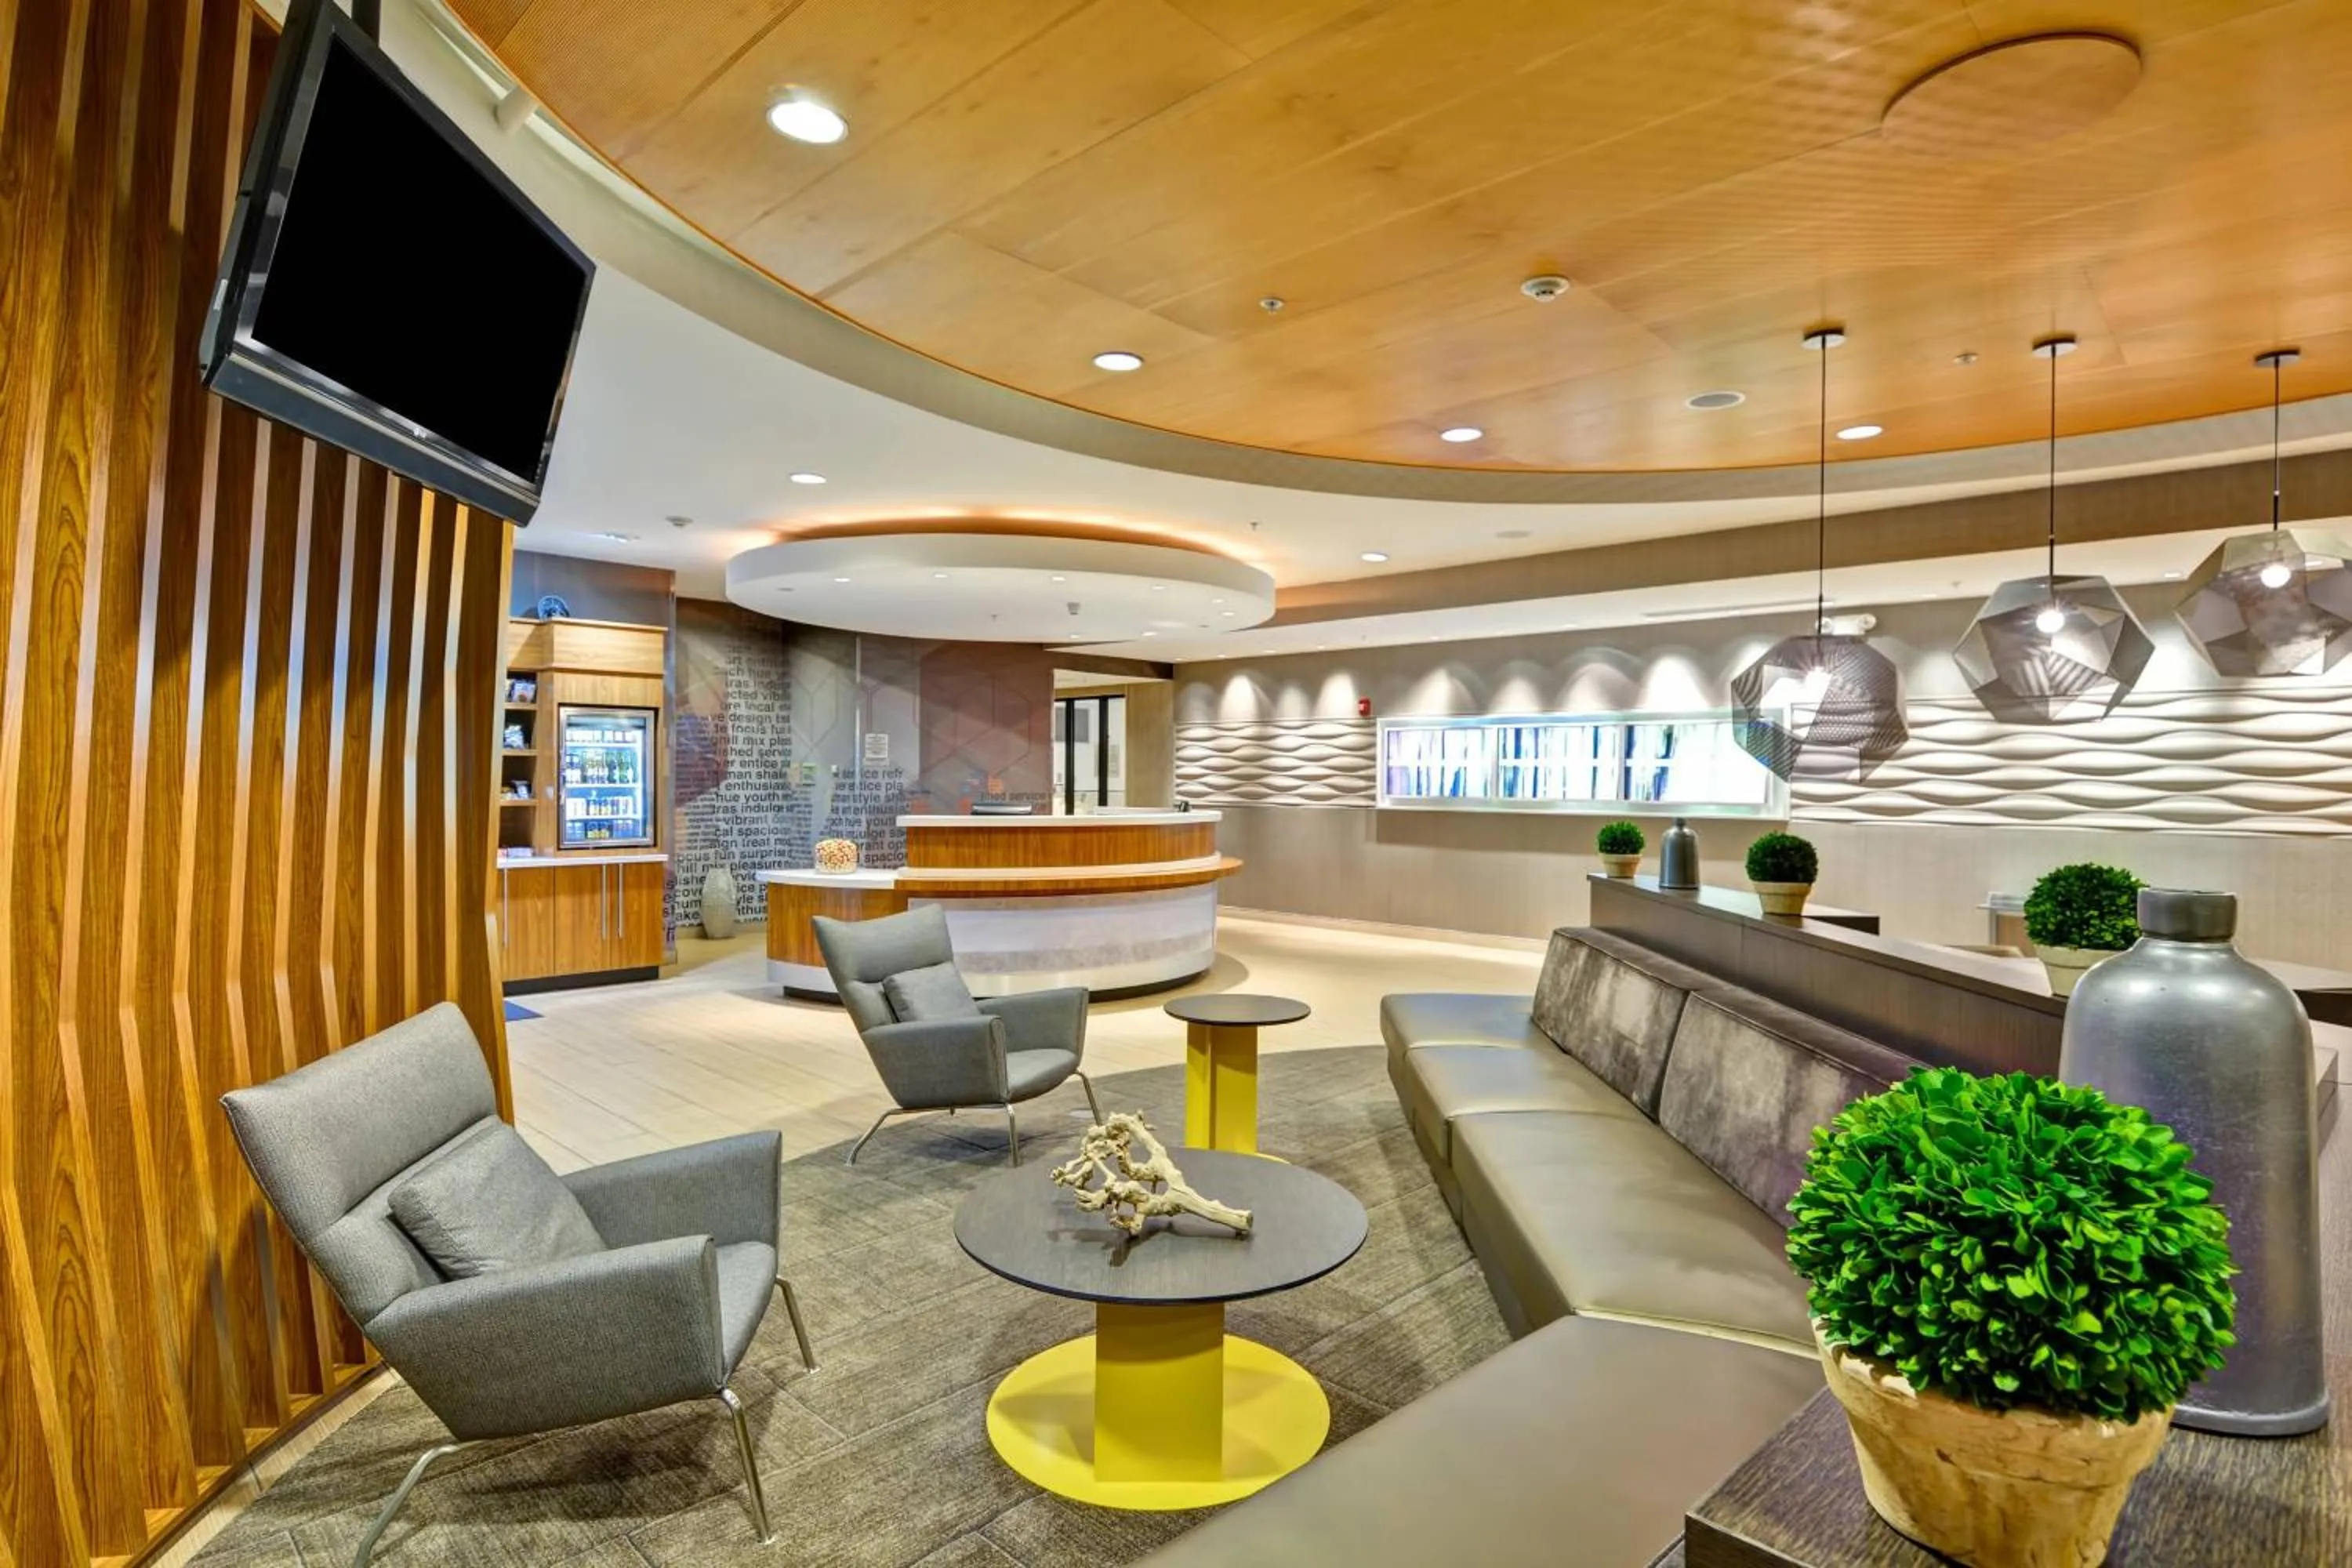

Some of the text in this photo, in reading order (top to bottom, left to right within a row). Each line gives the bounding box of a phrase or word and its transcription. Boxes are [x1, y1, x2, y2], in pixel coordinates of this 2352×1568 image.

[728, 712, 771, 726] design
[731, 724, 766, 734] focus
[739, 759, 779, 769] entice
[743, 792, 779, 804] youth
[715, 849, 735, 861] fun
